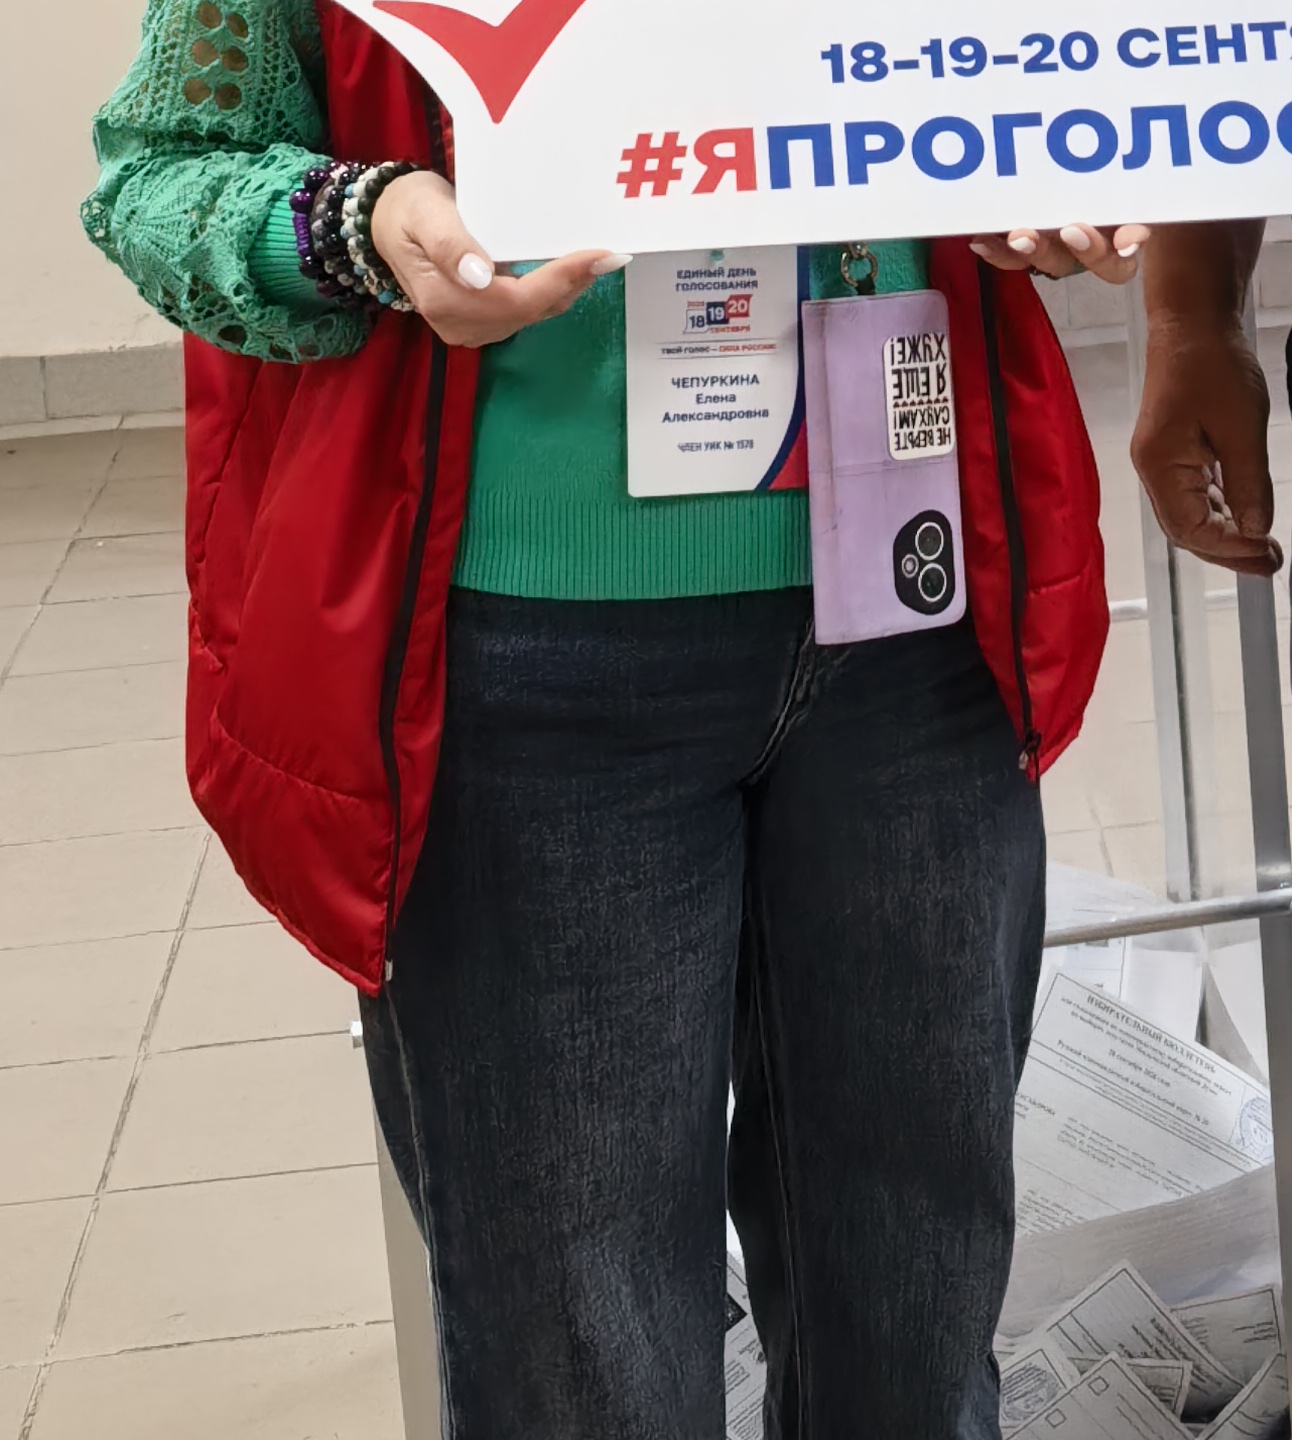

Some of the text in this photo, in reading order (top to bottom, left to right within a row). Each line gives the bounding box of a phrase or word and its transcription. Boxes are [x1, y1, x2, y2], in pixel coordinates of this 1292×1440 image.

[820, 28, 1100, 84] 18-19-20
[676, 266, 757, 279] ЕДИНЫЙ ДЕНЬ
[676, 280, 758, 292] ГОЛОСОВАНИЯ
[689, 300, 748, 328] 18 19 20
[890, 332, 947, 366] ХУЖЕ!
[671, 374, 760, 389] ЧЕПУРКИНА
[891, 362, 947, 400] Я ЕЩЕ
[696, 393, 737, 405] Елена
[662, 408, 769, 423] Александровна
[893, 406, 950, 430] СЛУХАМ!
[704, 441, 722, 451] УИК
[894, 427, 951, 451] НЕ ВЕРЬТЕ
